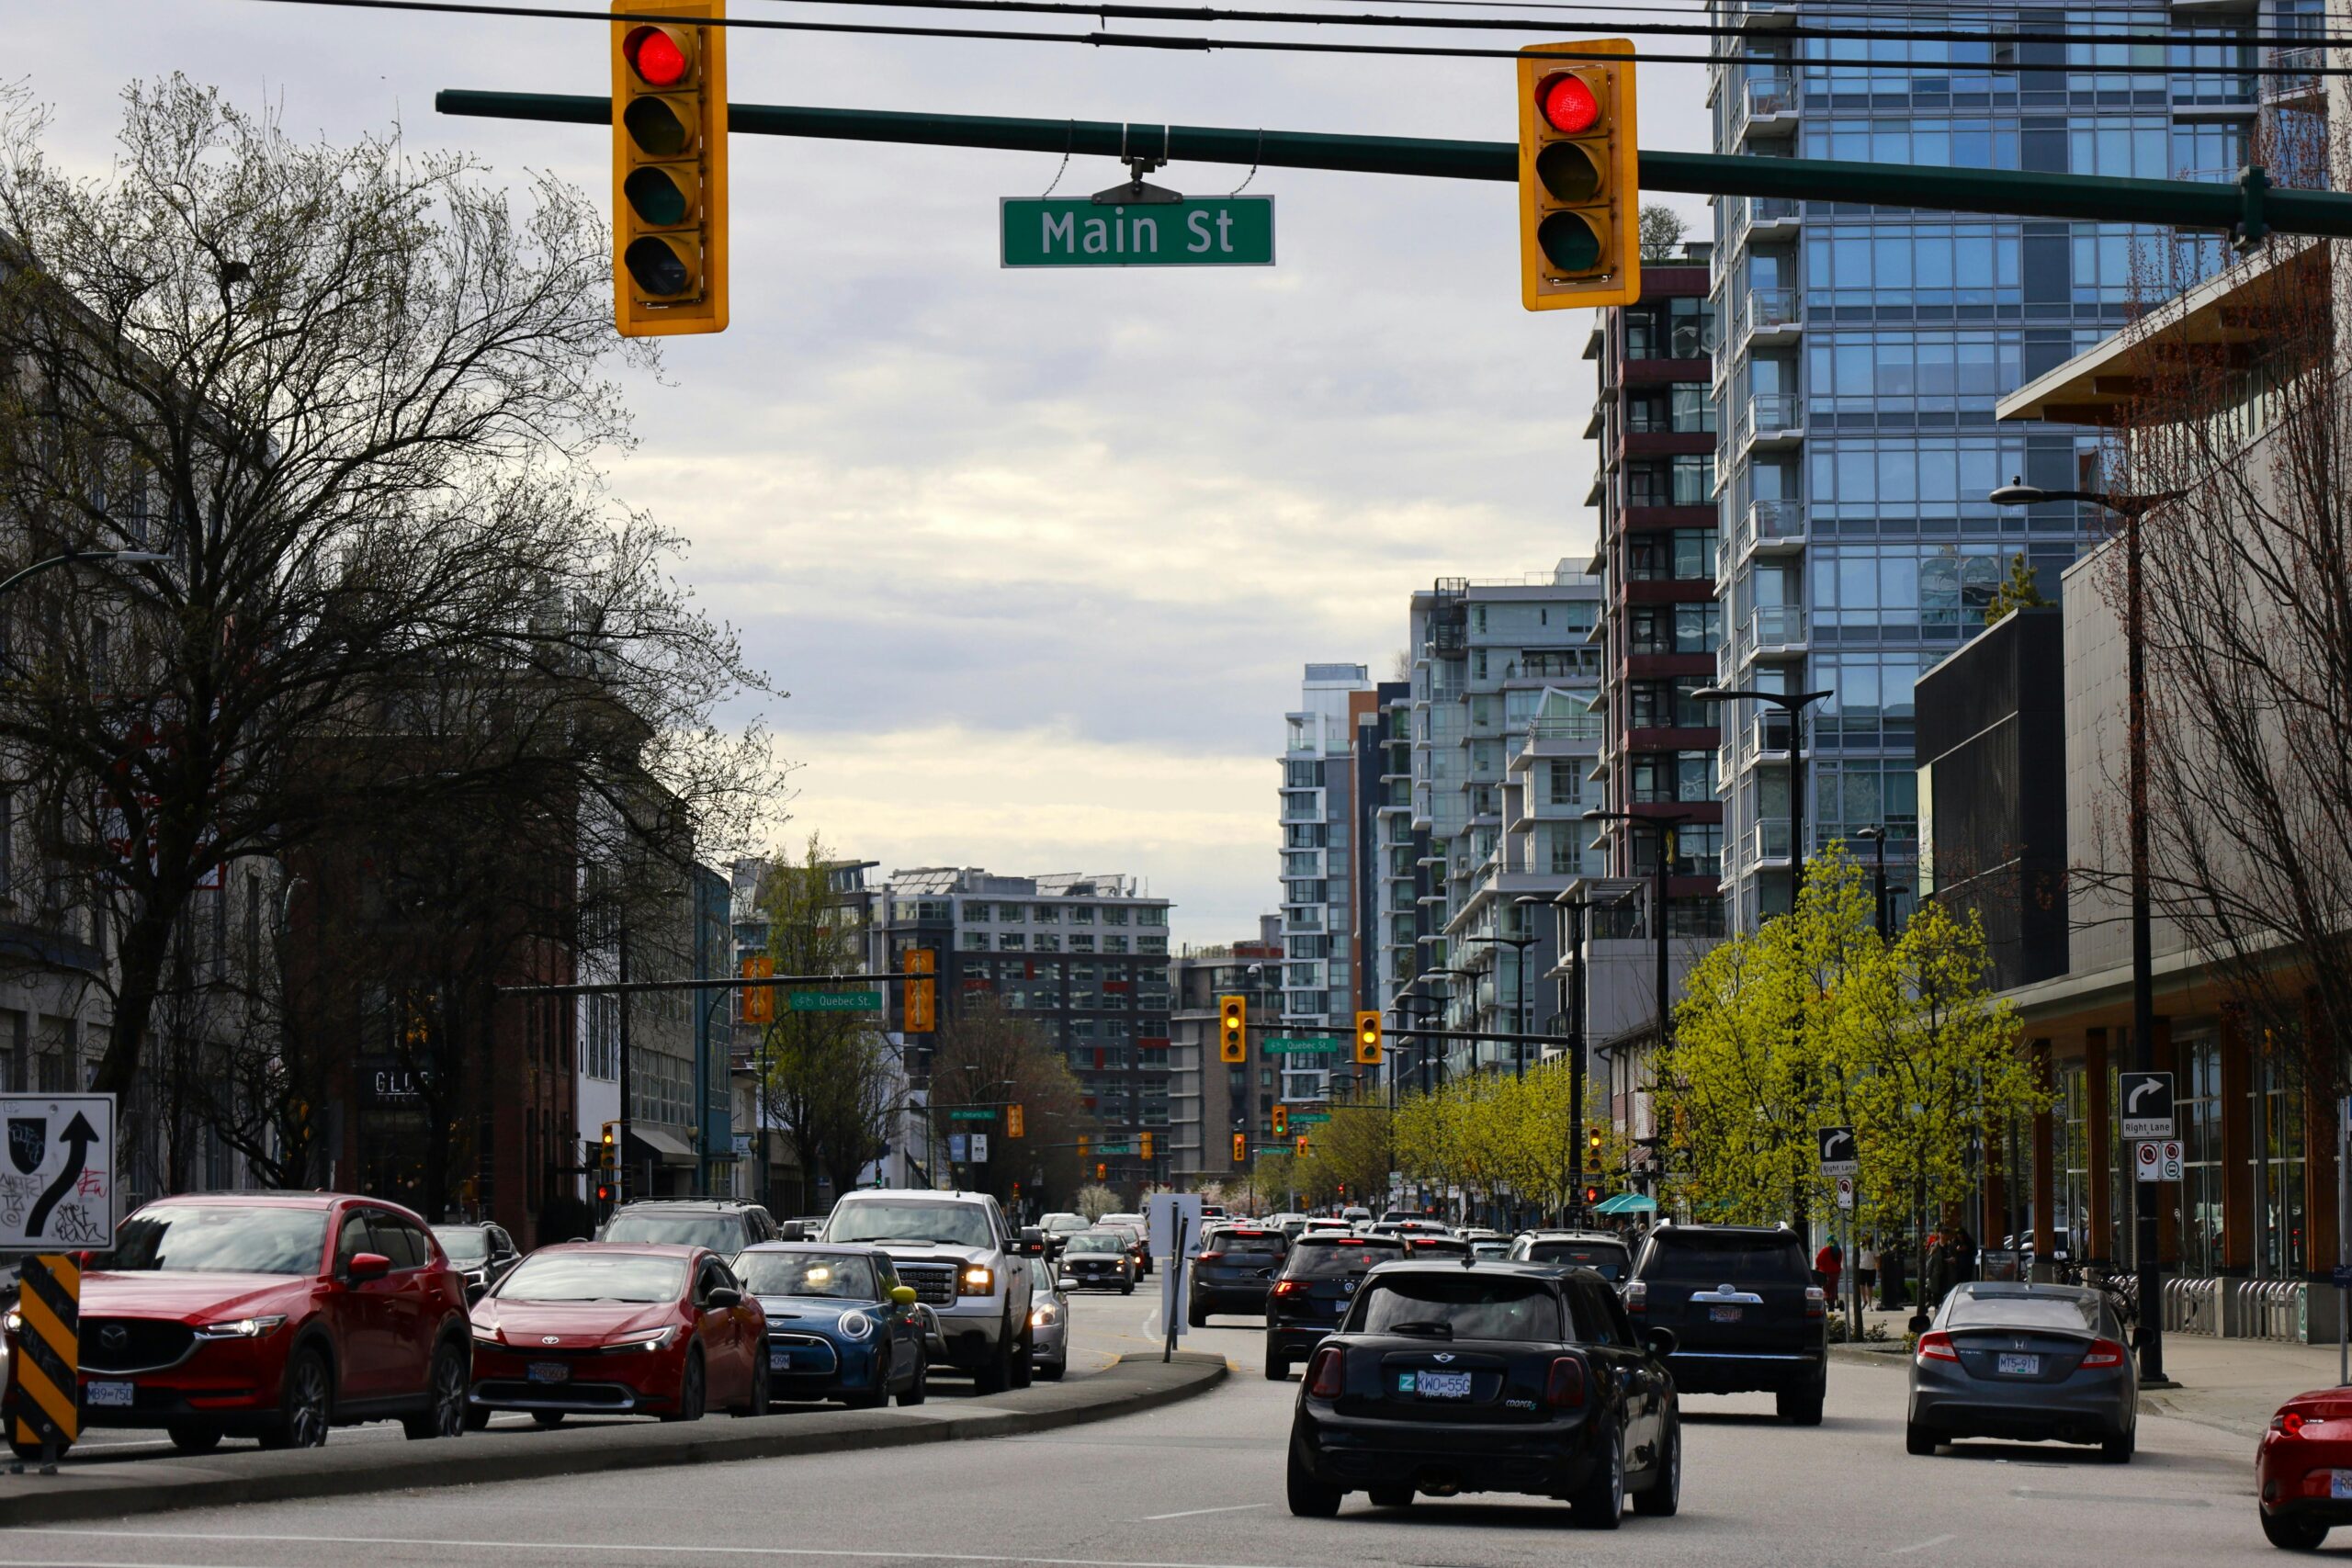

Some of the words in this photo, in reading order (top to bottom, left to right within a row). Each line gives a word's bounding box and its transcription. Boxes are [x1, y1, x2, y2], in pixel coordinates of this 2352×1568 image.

[1042, 207, 1158, 254] Main
[1187, 209, 1234, 253] St
[820, 995, 854, 1007] Quebec
[1287, 1041, 1316, 1050] Quebec
[2125, 1123, 2147, 1134] Right
[2151, 1123, 2170, 1132] Lane
[1823, 1165, 1839, 1173] Right
[1841, 1162, 1857, 1171] Lane
[1506, 1399, 1532, 1407] COOPER
